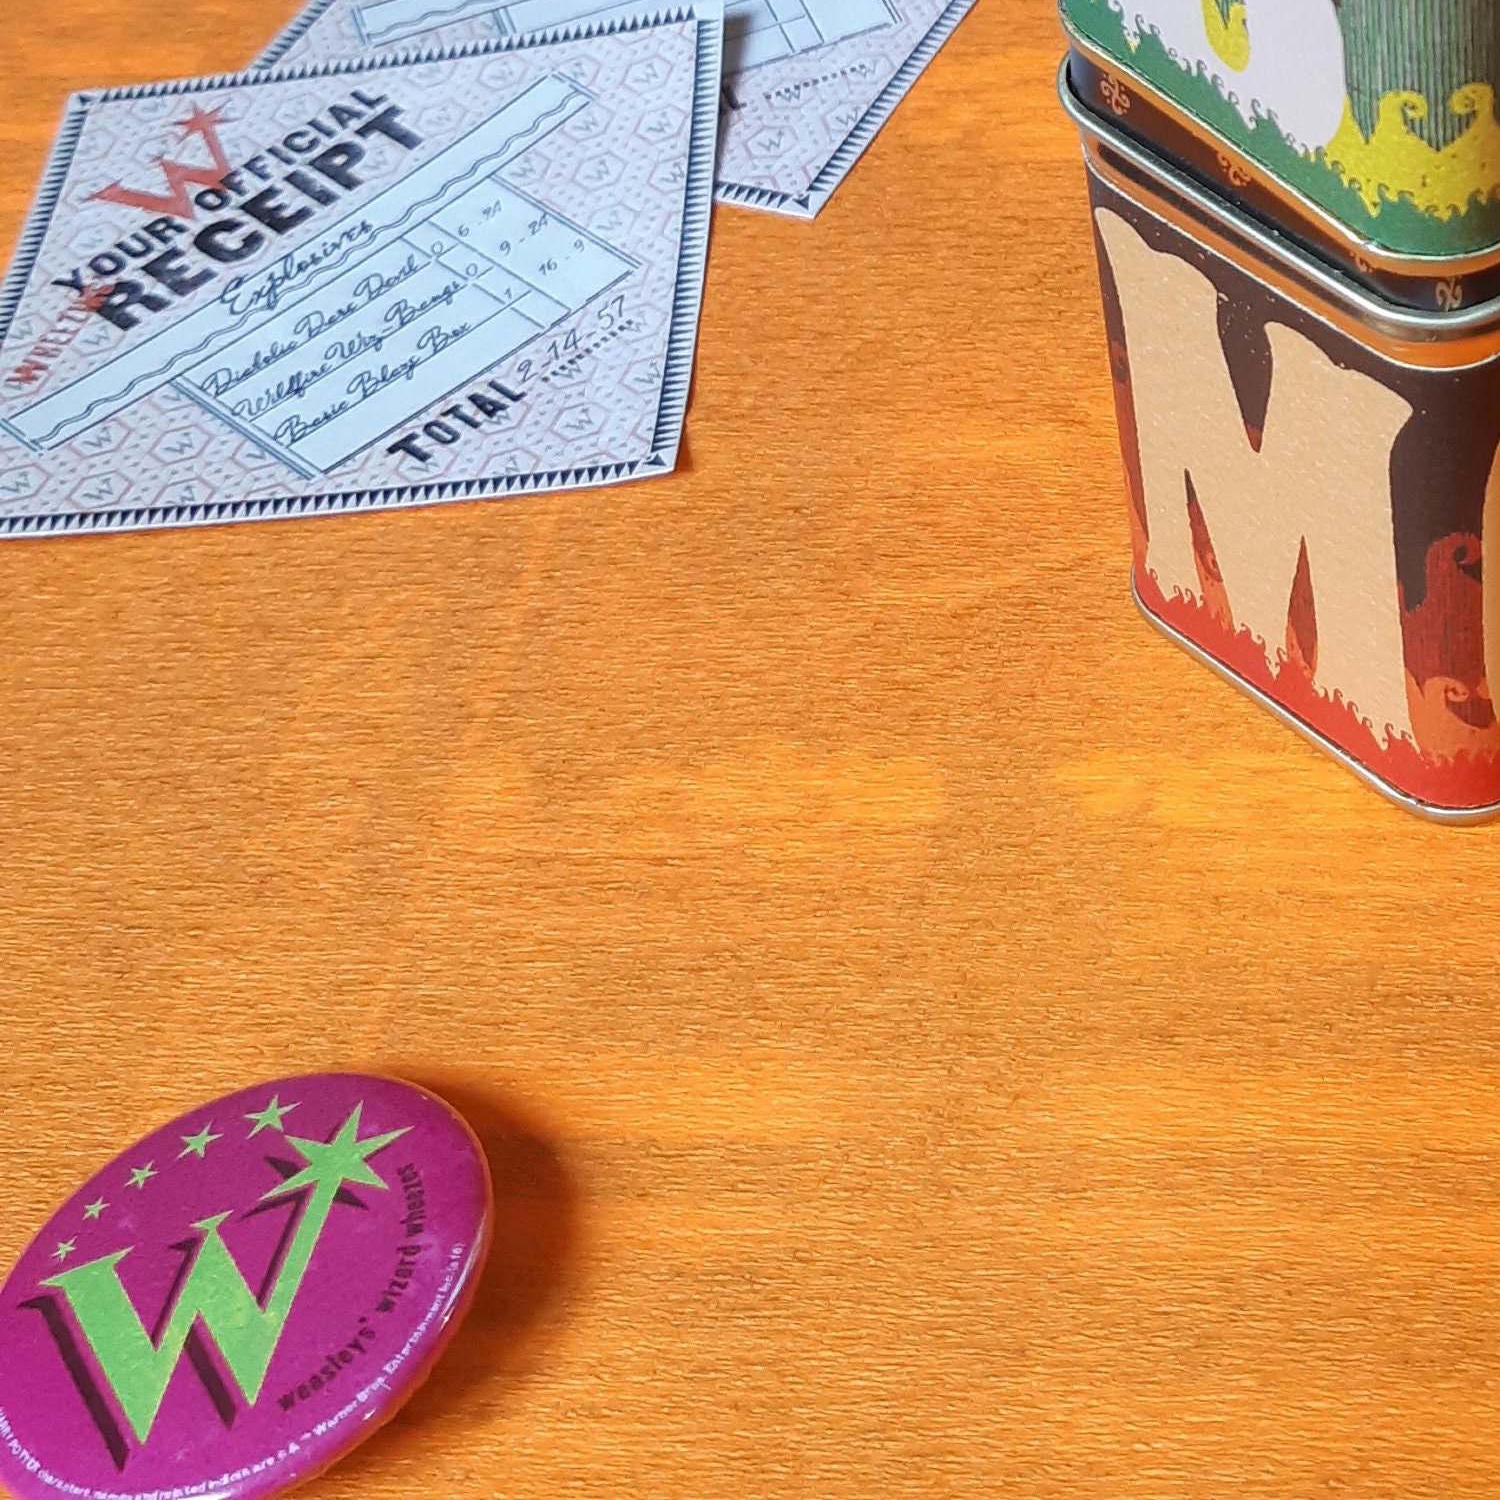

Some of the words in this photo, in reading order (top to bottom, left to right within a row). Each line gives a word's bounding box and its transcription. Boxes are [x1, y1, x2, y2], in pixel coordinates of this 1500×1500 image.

[51, 214, 188, 295] YOUR
[194, 87, 389, 213] OFFICIAL
[97, 106, 423, 331] RECEIPT
[220, 219, 374, 315] Explosives
[201, 339, 299, 398] Diabolic
[294, 301, 358, 339] Dare
[231, 363, 331, 417] Wildfire
[274, 400, 349, 446] Basic
[346, 353, 421, 401] Blaze
[417, 322, 470, 355] Box
[387, 380, 527, 463] TOTAL
[376, 1245, 420, 1313] wizard
